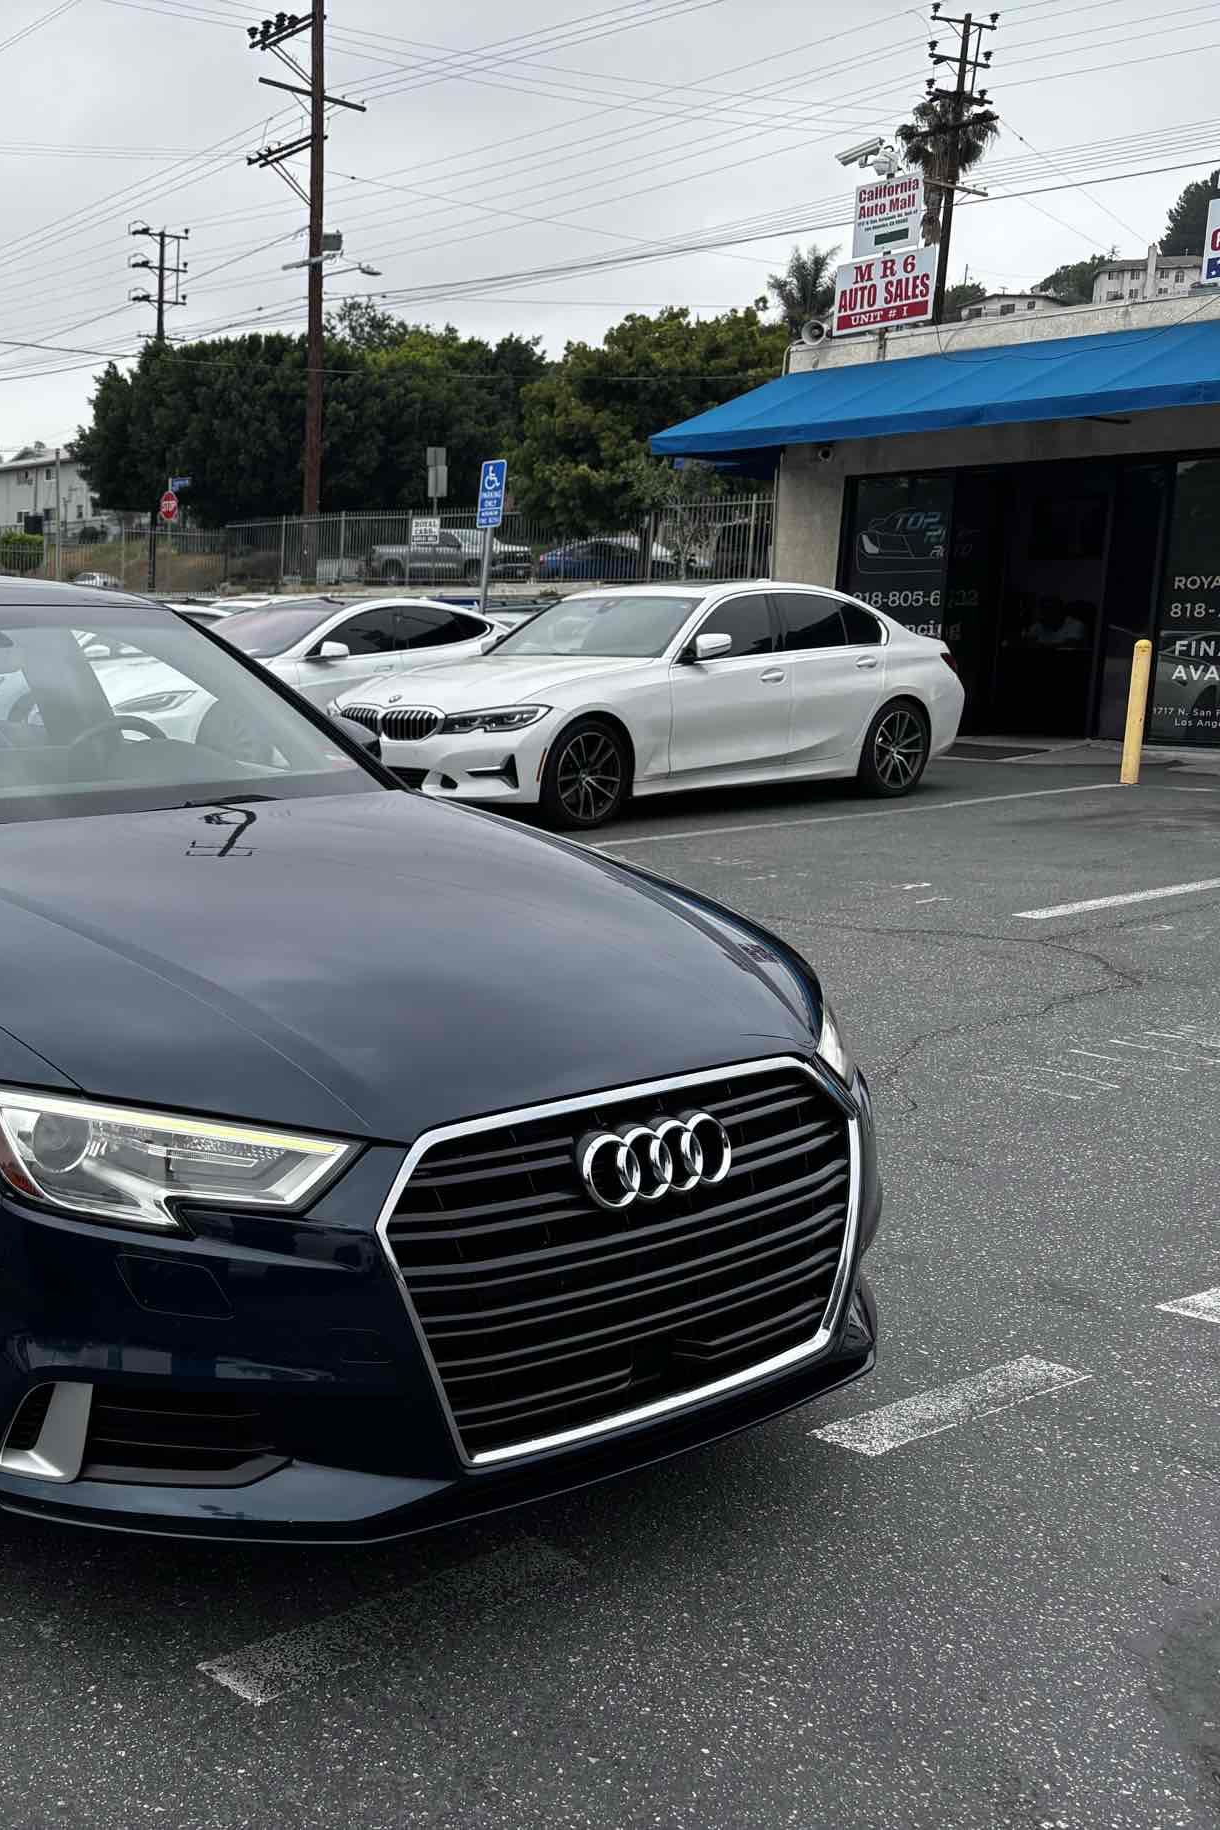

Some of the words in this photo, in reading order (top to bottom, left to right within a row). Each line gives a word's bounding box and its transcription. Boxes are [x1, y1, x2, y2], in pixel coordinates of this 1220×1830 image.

[858, 177, 920, 204] California
[858, 203, 887, 220] Auto
[888, 193, 916, 213] Mall
[852, 262, 875, 285] M
[879, 258, 897, 279] R
[902, 254, 916, 274] 6
[837, 283, 878, 314] AUTO
[883, 272, 930, 305] SALES
[850, 311, 884, 326] UNIT
[888, 309, 897, 319] #
[161, 501, 177, 512] STOP
[892, 512, 942, 529] TOP
[1170, 602, 1220, 618] 818-
[1174, 640, 1220, 657] FIN
[1193, 709, 1212, 717] San
[1174, 720, 1193, 728] Los
